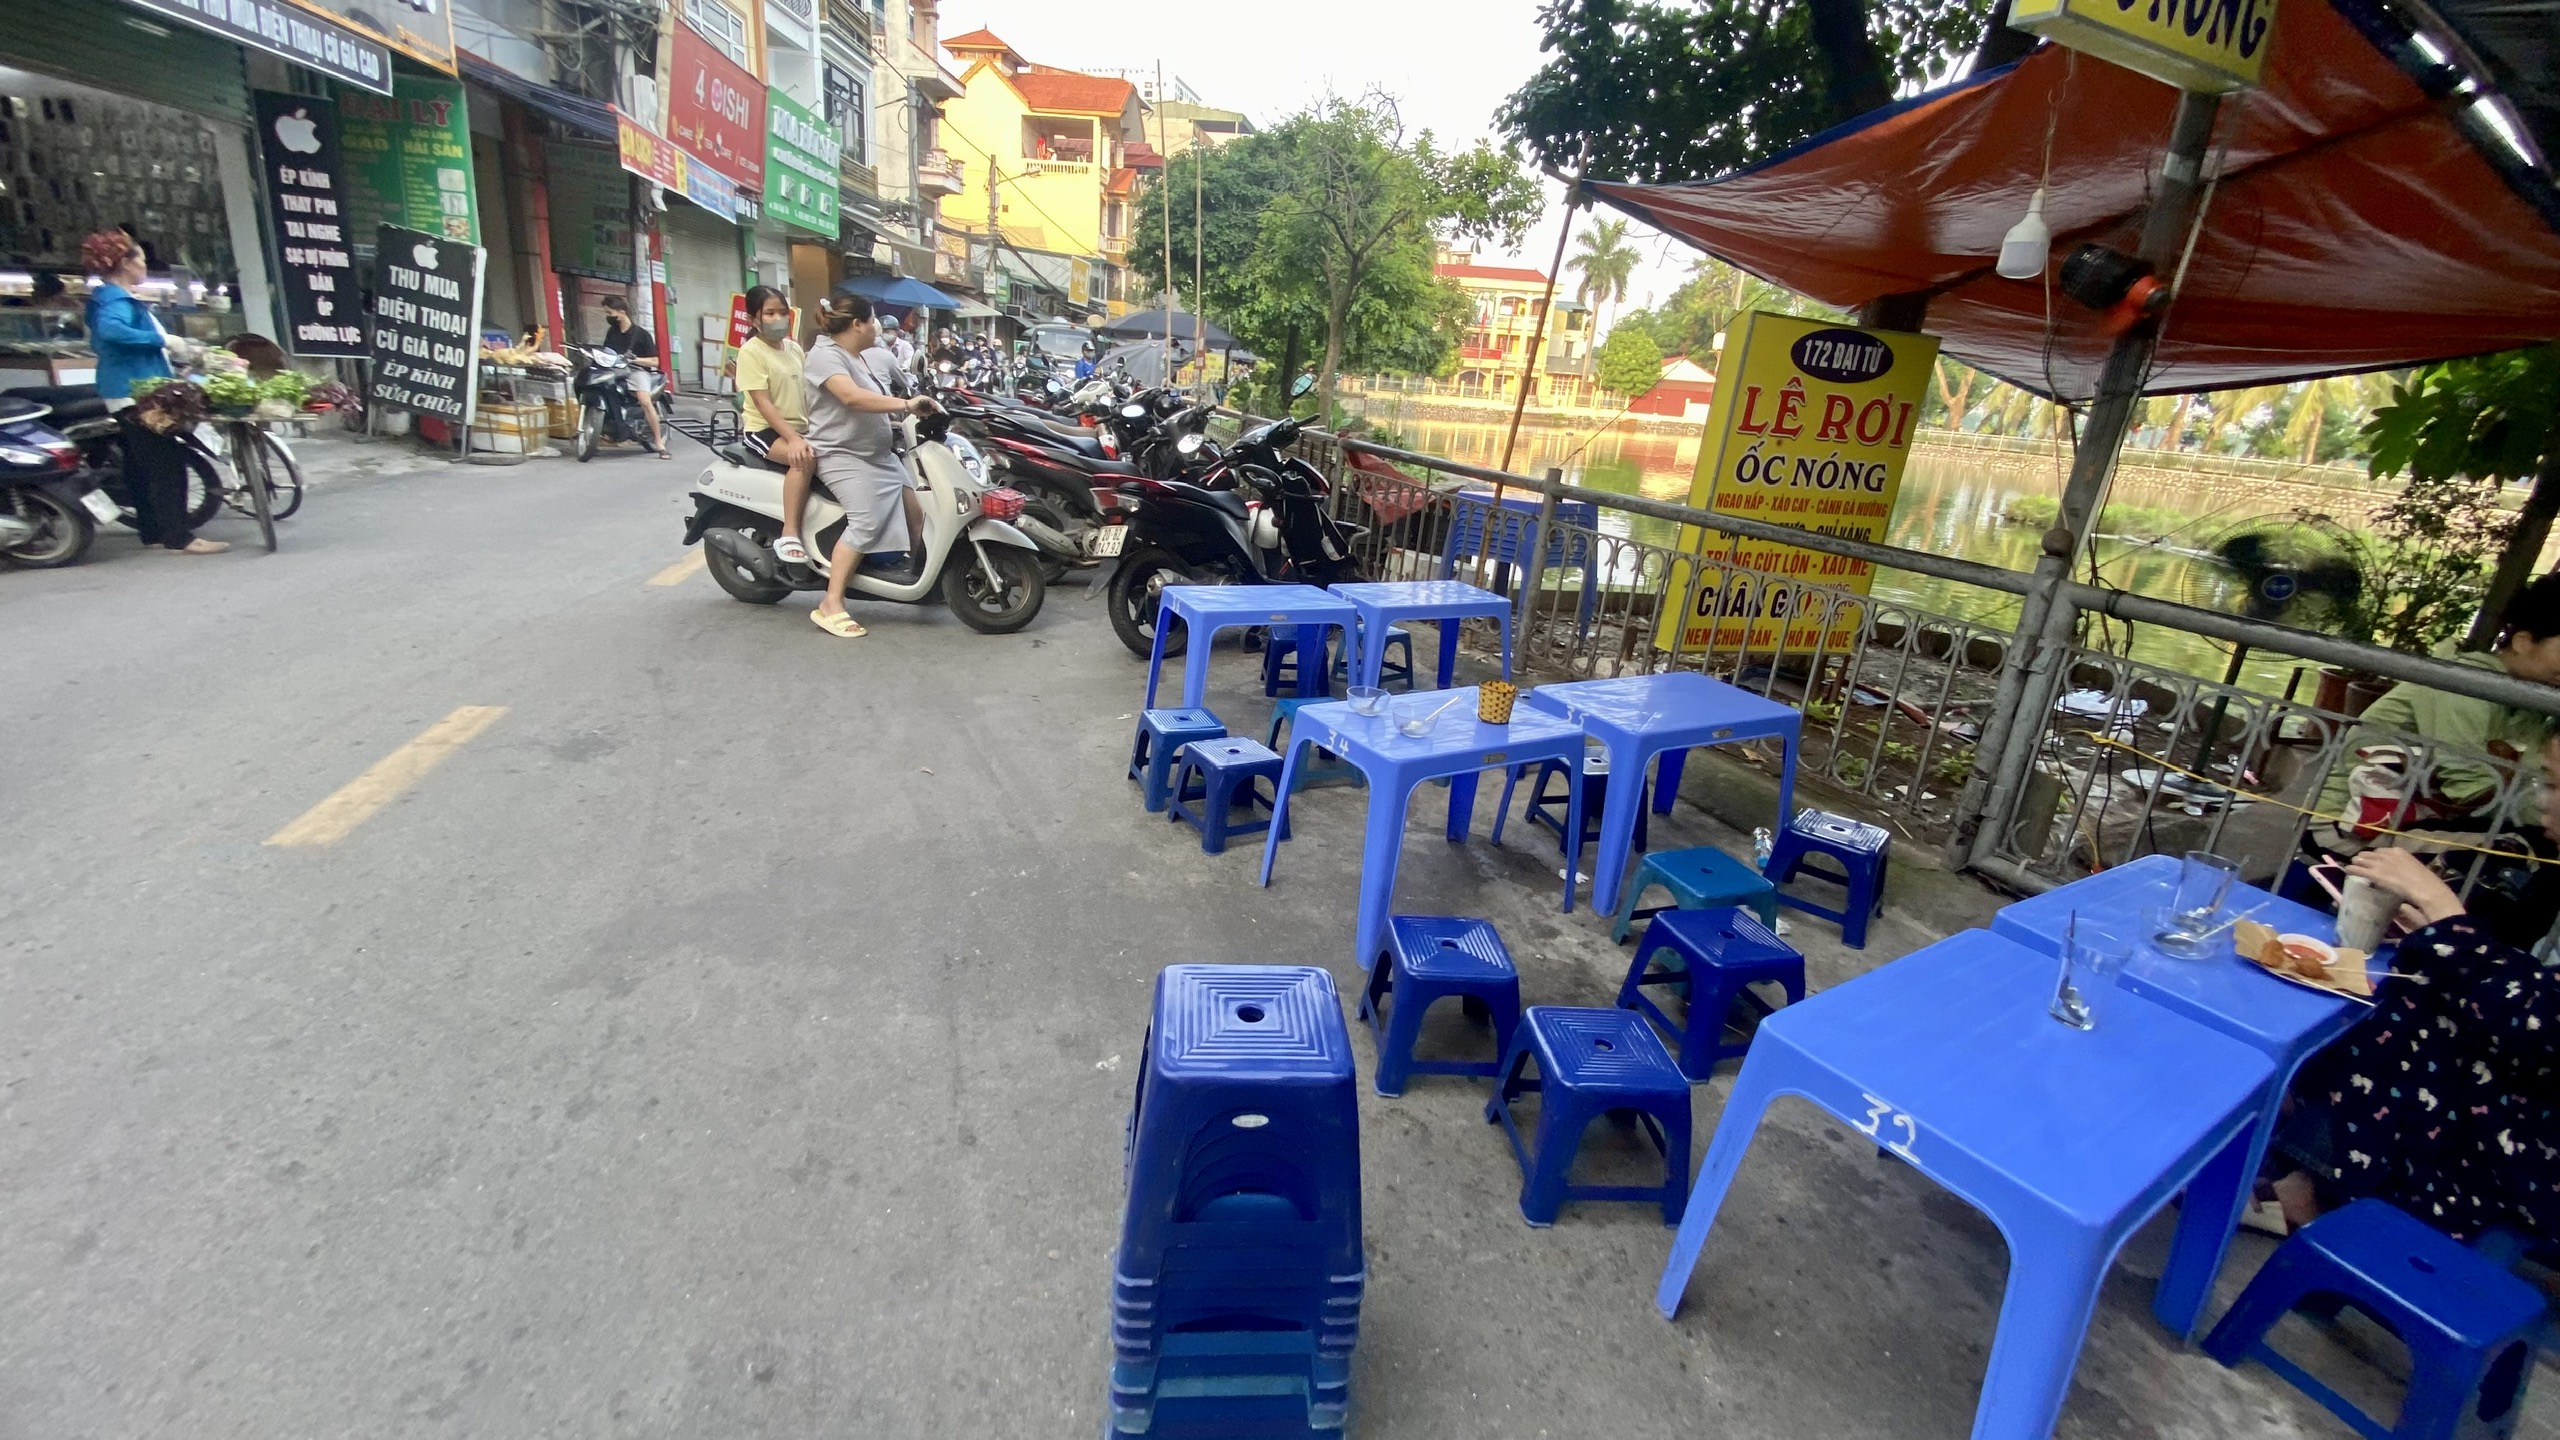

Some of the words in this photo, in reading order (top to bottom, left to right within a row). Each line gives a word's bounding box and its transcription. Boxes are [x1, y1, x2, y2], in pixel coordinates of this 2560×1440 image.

[359, 48, 380, 81] CAO
[695, 69, 705, 104] 4
[711, 78, 750, 131] OISHI
[280, 165, 296, 184] ÉP
[281, 194, 311, 213] THAY
[314, 198, 337, 216] PIN
[285, 221, 306, 238] TAI
[307, 223, 341, 242] NGHE
[389, 265, 420, 290] THU
[424, 274, 460, 301] MUA
[378, 296, 416, 324] ĐIỆN
[421, 307, 467, 338] THOẠI
[376, 329, 398, 351] CŨ
[402, 335, 429, 360] GIÁ
[433, 343, 465, 368] CAO
[1803, 339, 1833, 368] 172
[1832, 342, 1861, 376] ĐẠI
[383, 358, 409, 377] ÉP
[409, 367, 456, 390] KÍNH
[1736, 376, 1806, 446] LỆ
[1735, 441, 1785, 485] ỐC
[1790, 452, 1886, 493] NÓNG
[719, 488, 751, 501] SCOOPY
[1716, 493, 1743, 509] NGAO
[1744, 490, 1764, 510] HẤP
[1792, 497, 1811, 513] CAY
[1816, 497, 1842, 514] CÁNH
[1753, 549, 1781, 573] CÚT
[1684, 628, 1712, 645] NEM
[1828, 630, 1850, 648] QUE
[1326, 728, 1349, 756] 34
[1850, 1093, 1921, 1164] 32
